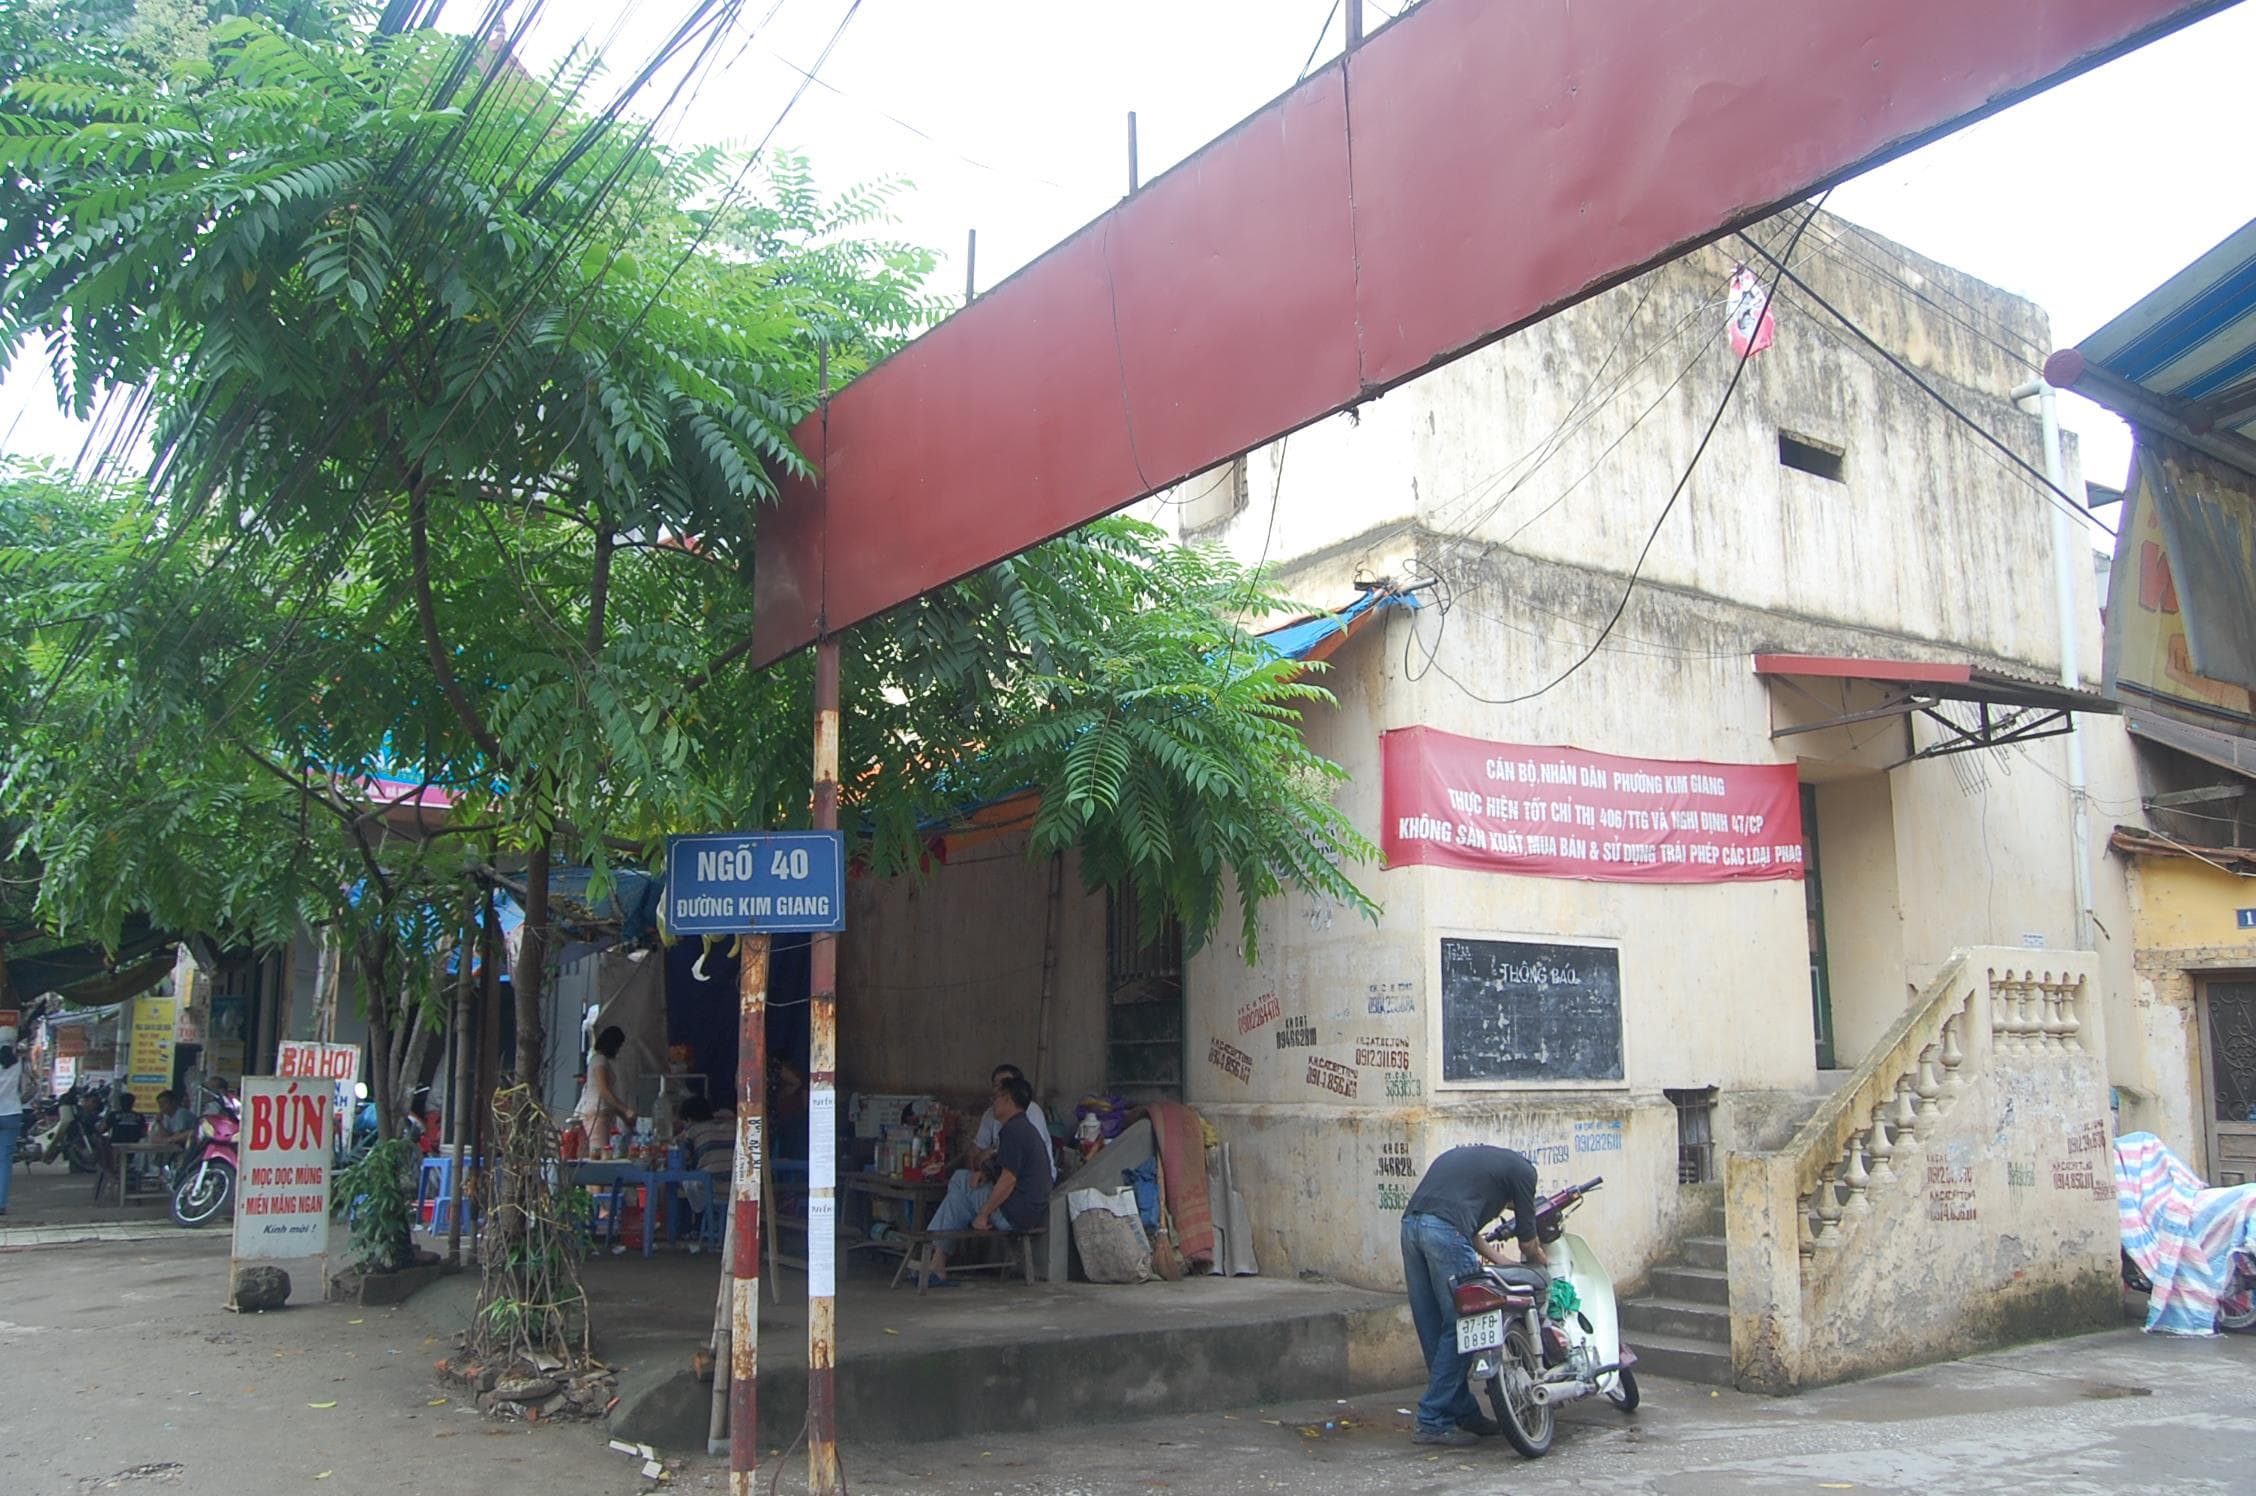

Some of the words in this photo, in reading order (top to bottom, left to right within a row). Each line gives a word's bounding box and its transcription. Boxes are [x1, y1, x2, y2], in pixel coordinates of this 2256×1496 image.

[1487, 757, 1515, 781] CÁN
[1541, 761, 1577, 785] NHÂN
[1581, 765, 1607, 790] DÂN
[1613, 769, 1662, 794] PHƯỜNG
[1664, 775, 1688, 794] KIM
[1690, 774, 1725, 796] GIANG
[1448, 788, 1483, 817] THỰC
[1486, 796, 1519, 822] HIỆN
[1523, 797, 1547, 822] TỐT
[1575, 804, 1595, 829] THỊ
[1399, 813, 1452, 842] KHÔNG
[1527, 834, 1558, 856] MUA
[1589, 843, 1600, 861] &
[1722, 840, 1745, 866] CÁC
[697, 843, 753, 882] NGÕ
[770, 848, 809, 880] 40
[677, 893, 734, 918] ĐƯỜNG
[738, 896, 771, 916] KIM
[776, 896, 829, 916] GIANG
[282, 1047, 315, 1078] BIA
[320, 1050, 353, 1080] HƠI
[249, 1082, 327, 1151] BÚN
[299, 1194, 323, 1214] NGAN
[1464, 1330, 1495, 1349] 0898
